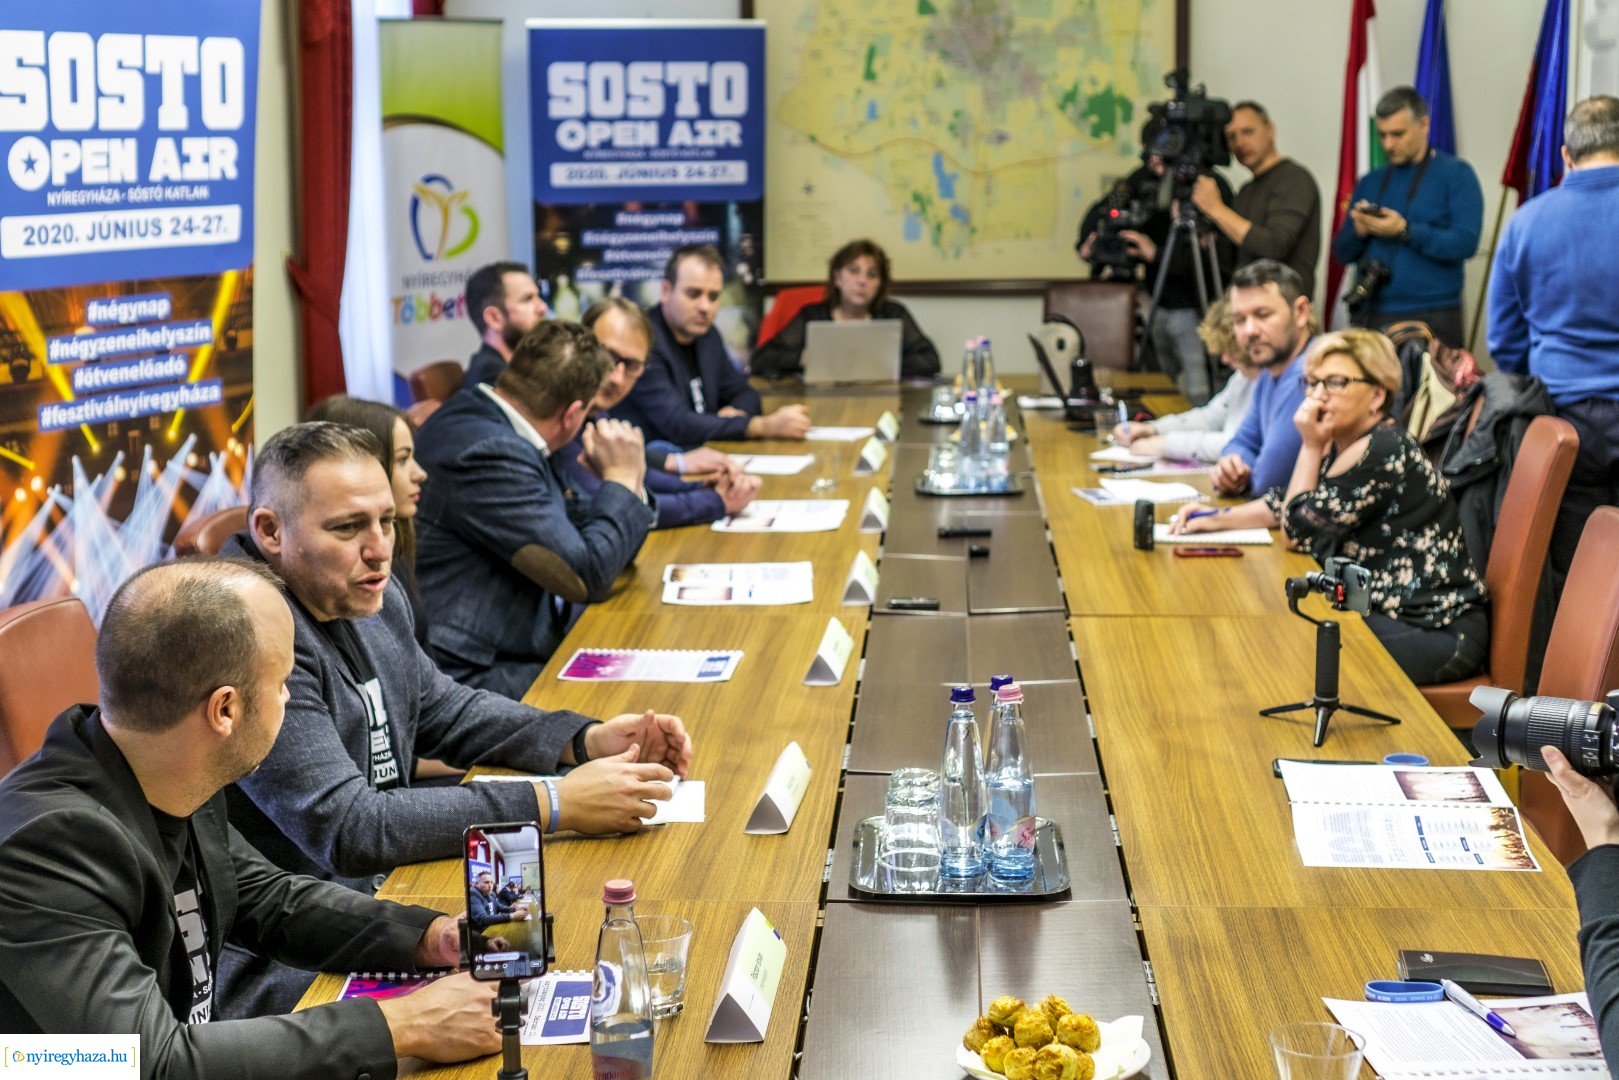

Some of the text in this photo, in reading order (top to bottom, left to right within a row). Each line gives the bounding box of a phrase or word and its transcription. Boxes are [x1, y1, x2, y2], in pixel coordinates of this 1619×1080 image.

[0, 30, 245, 132] SOSTO
[547, 61, 749, 119] SOSTO
[556, 120, 743, 151] OPEN AIR
[8, 136, 239, 192] OPEN AIR
[47, 188, 121, 206] NYÍREGYHÁZA
[165, 185, 209, 200] KATLAN
[23, 215, 228, 246] 2020. JÚNIUS 24-27.
[87, 297, 170, 322] #négynap
[49, 322, 212, 361] #négyzeneihelyszín
[74, 356, 187, 389] #ötvenelőadó
[41, 383, 220, 428] #fesztiválnyíregyháza
